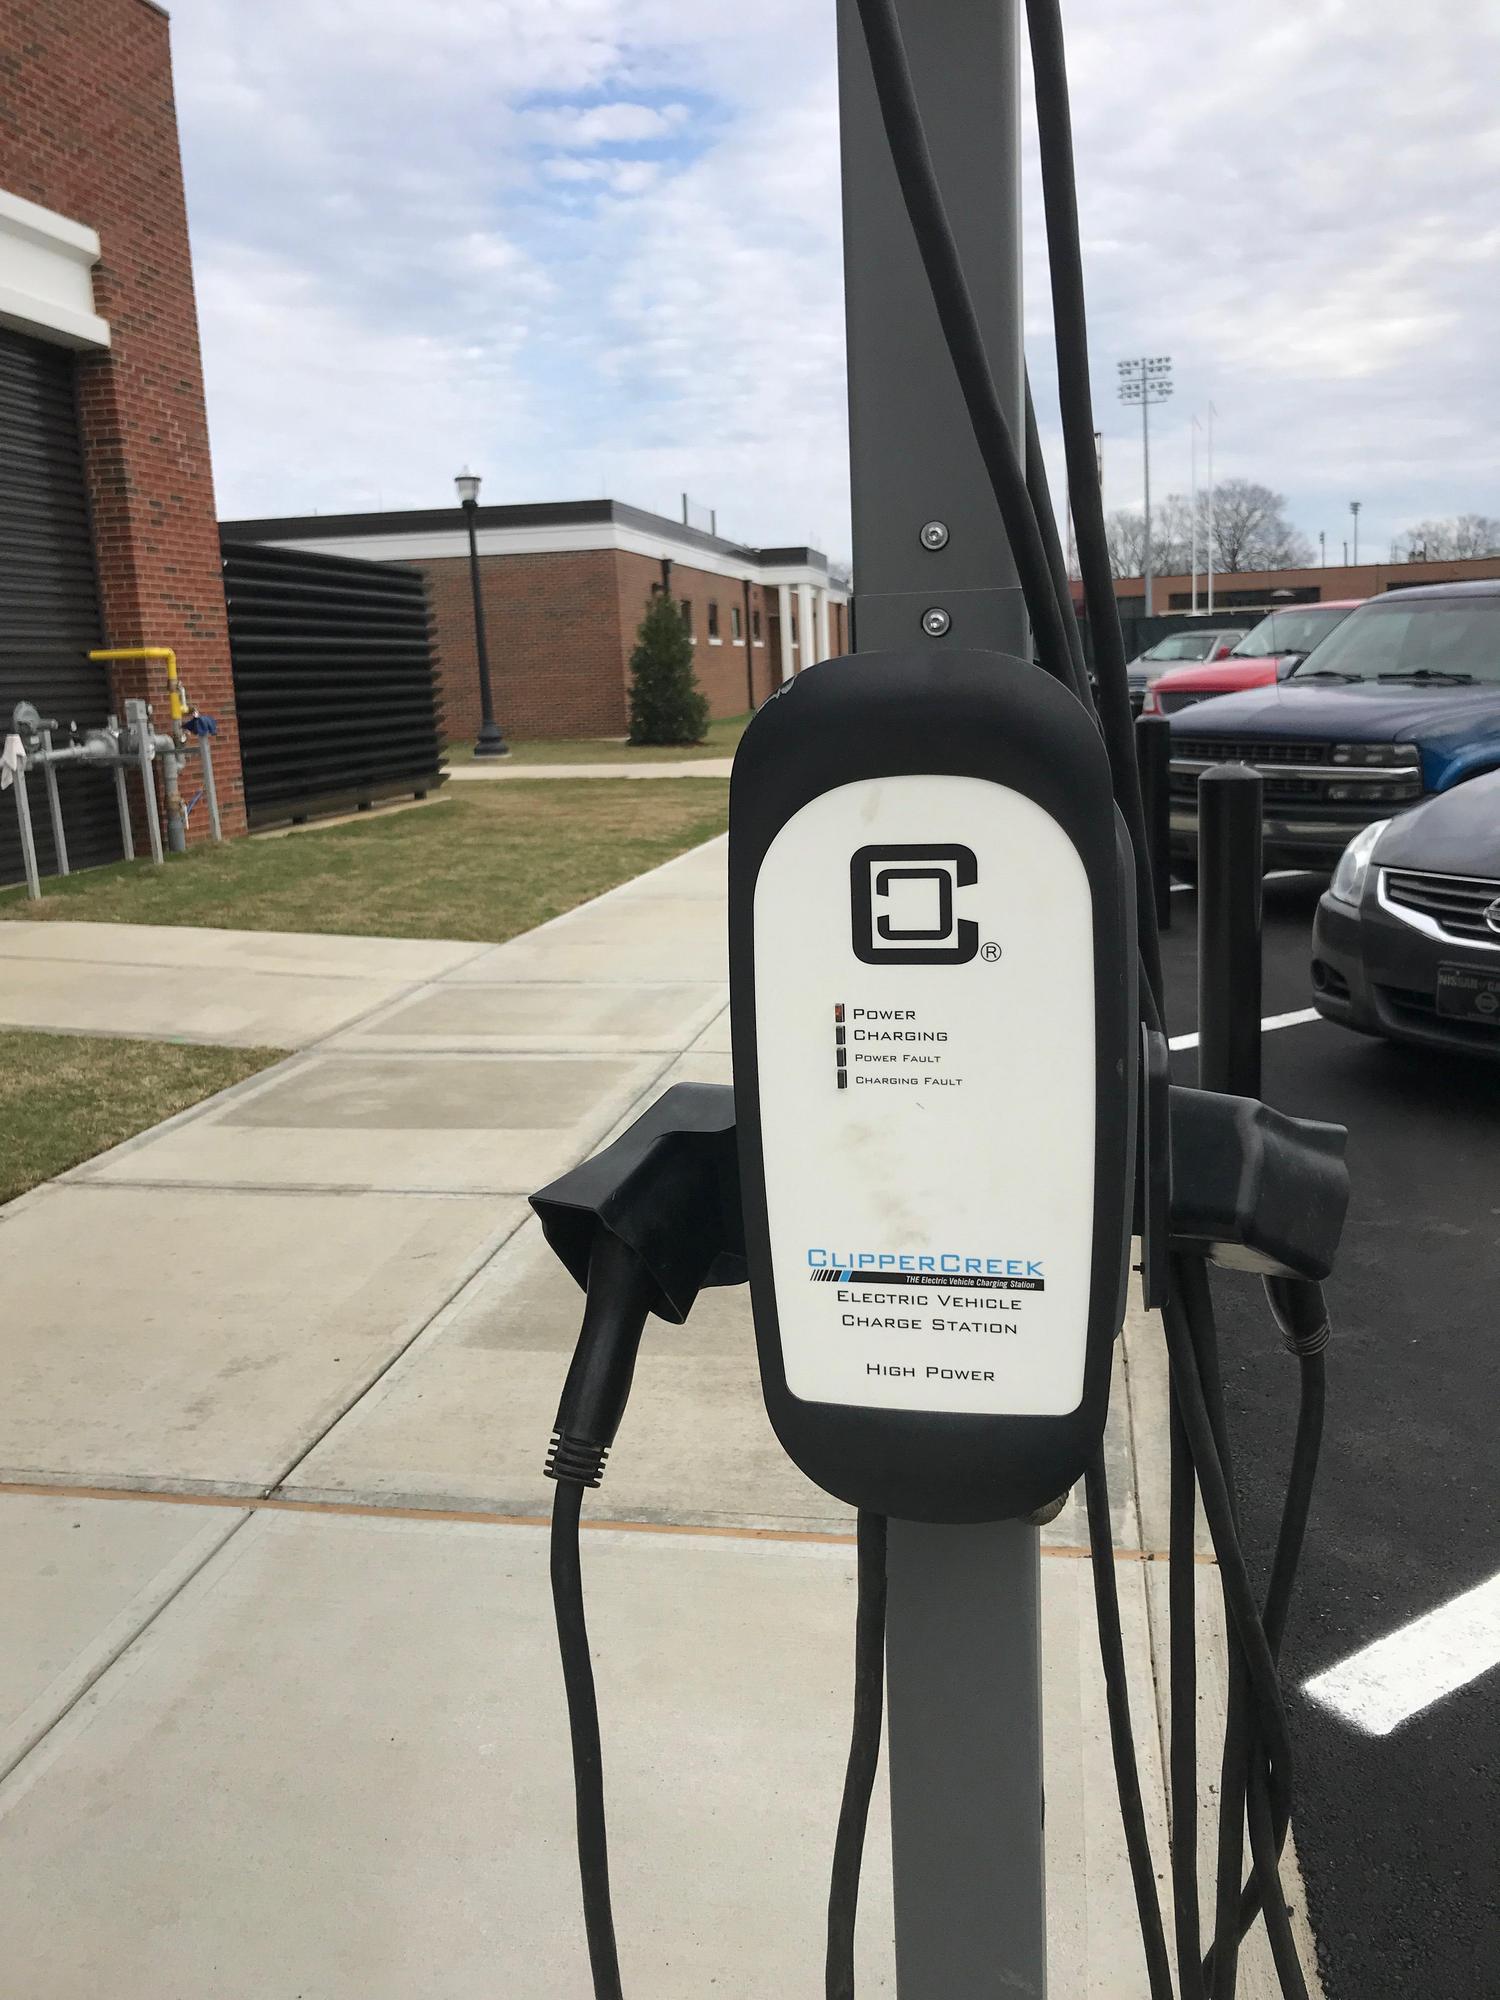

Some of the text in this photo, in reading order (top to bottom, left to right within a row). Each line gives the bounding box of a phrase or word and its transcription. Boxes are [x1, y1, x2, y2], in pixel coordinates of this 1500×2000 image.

[854, 1009, 915, 1020] POWER
[854, 1030, 947, 1041] CHARGING
[855, 1054, 896, 1062] POWER
[856, 1076, 918, 1084] CHARGING
[808, 1249, 1044, 1276] CLIPPERCREEK
[906, 1275, 1035, 1289] THE Electric Vehicle Charging Station
[838, 1290, 1021, 1310] ELECTRIC VEHICLE
[842, 1315, 1016, 1334] CHARGE STATION
[867, 1364, 994, 1381] HIGH POWER
